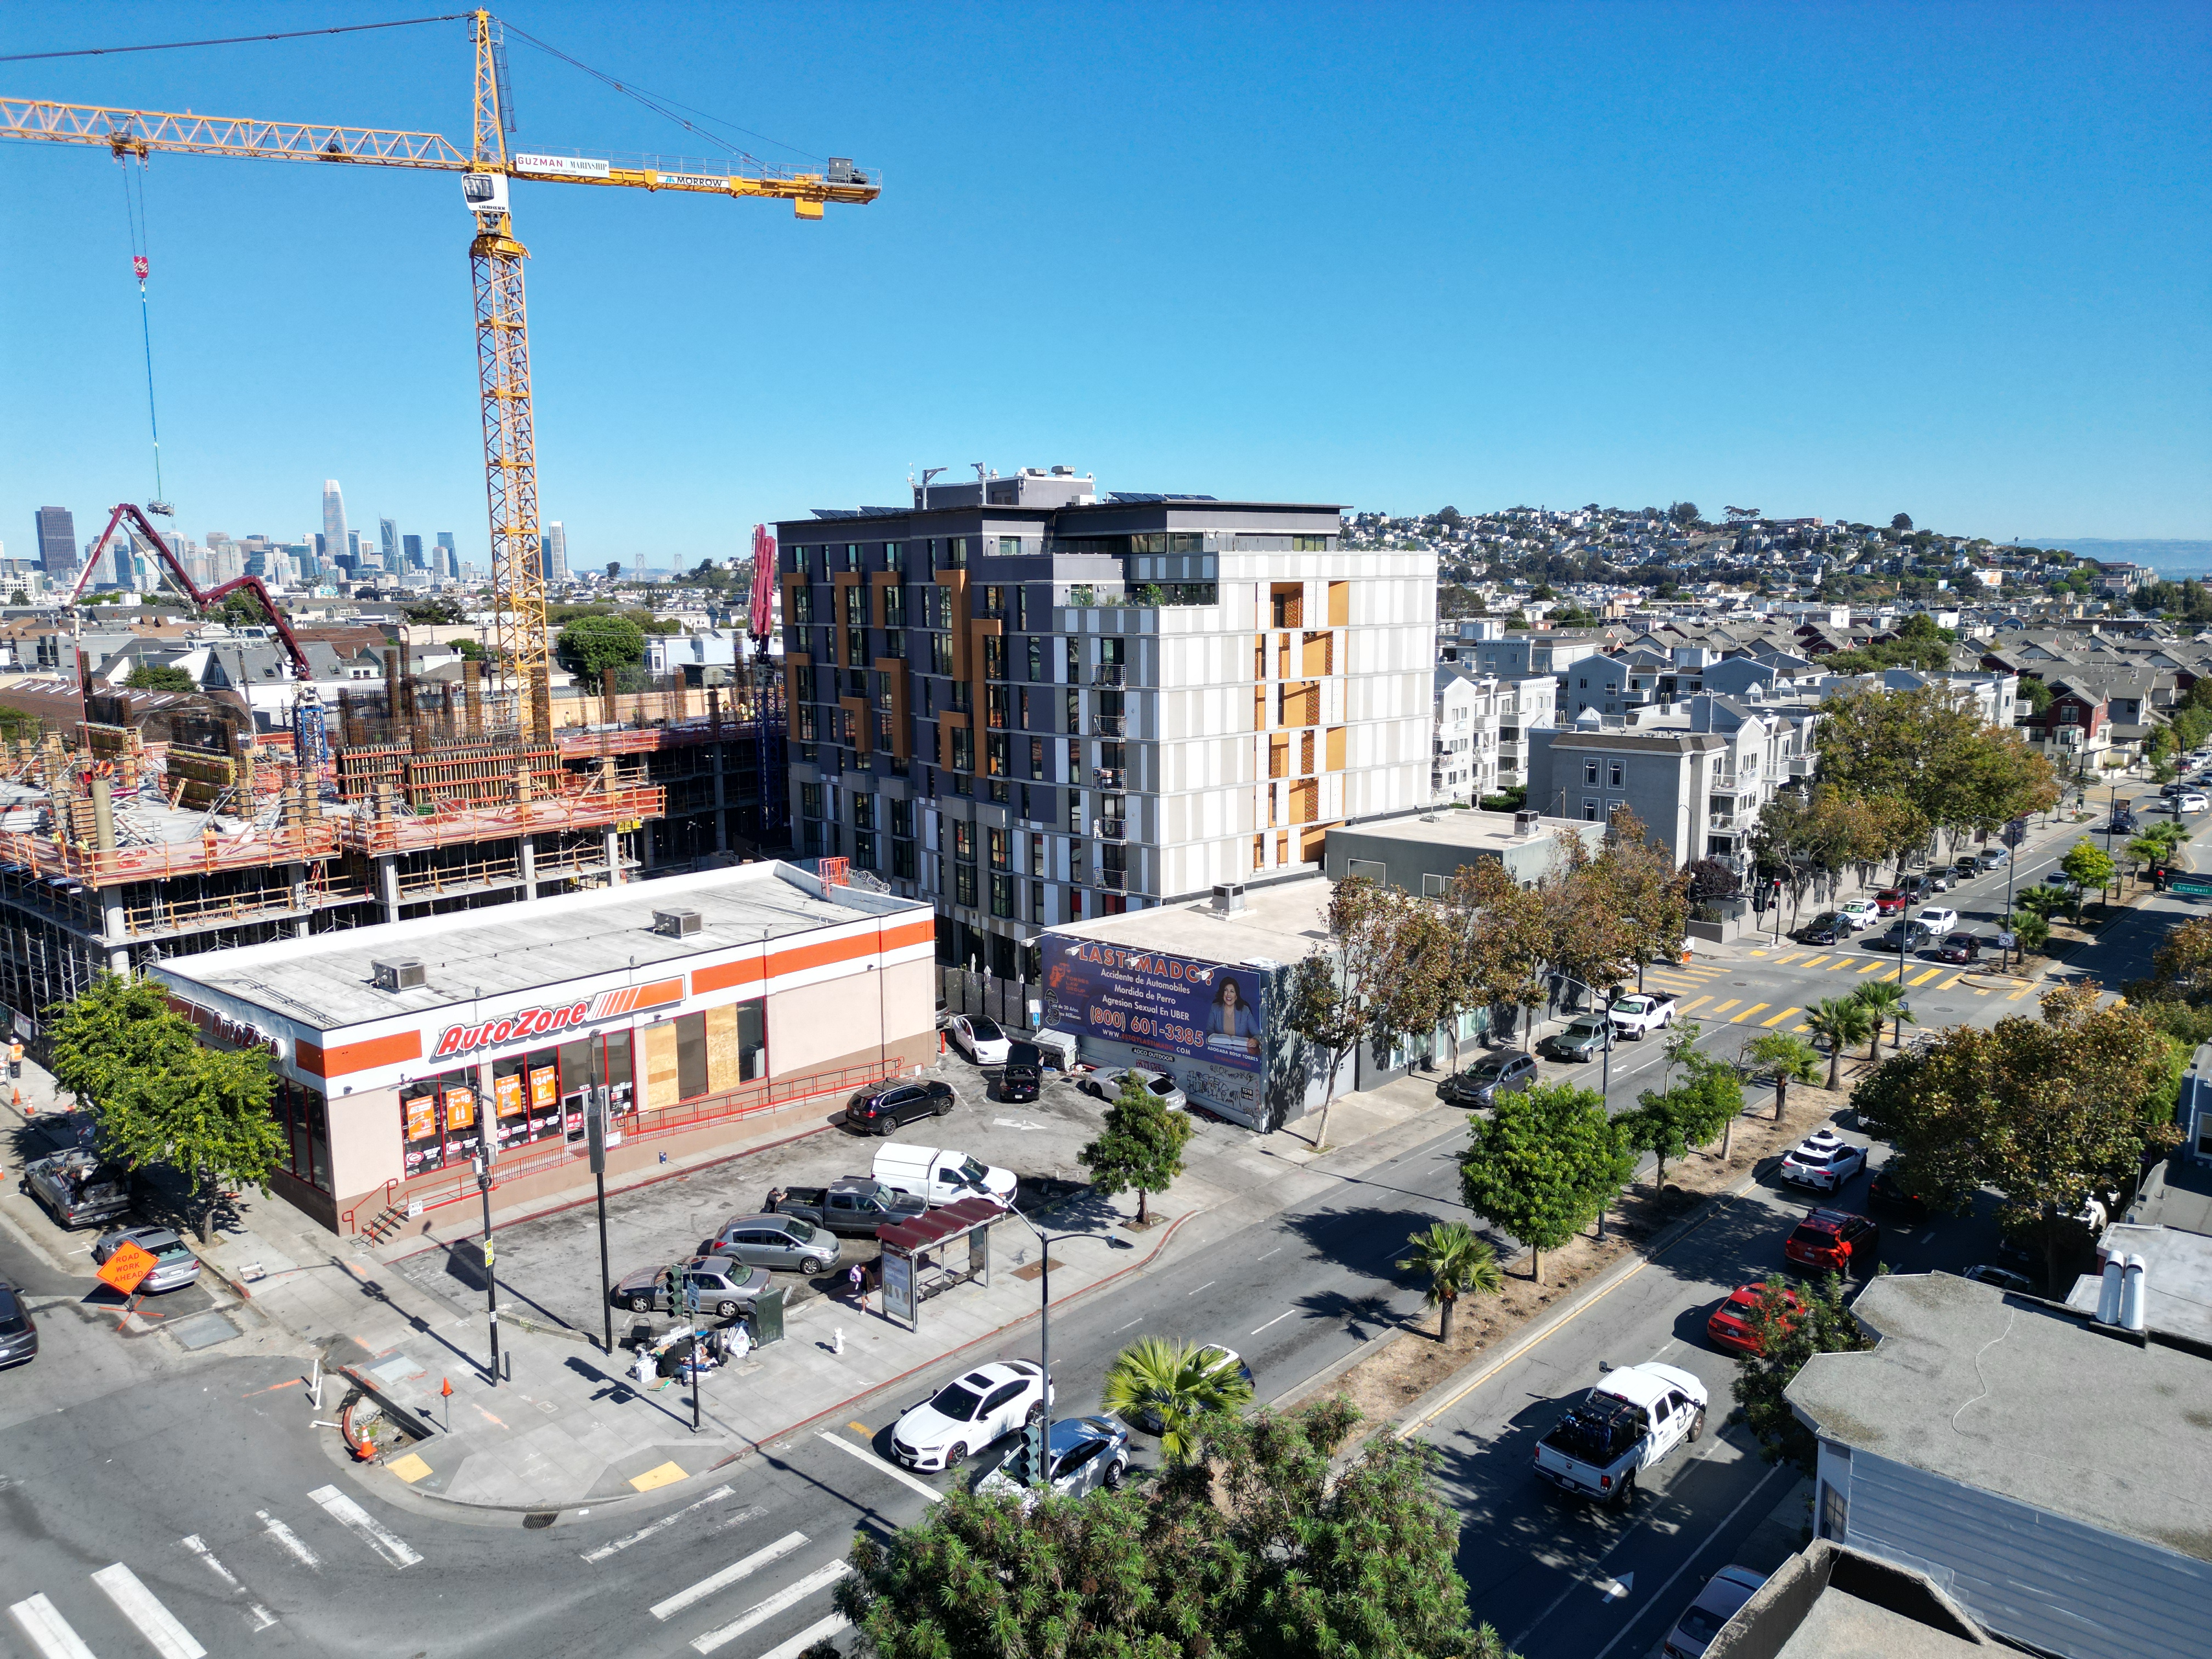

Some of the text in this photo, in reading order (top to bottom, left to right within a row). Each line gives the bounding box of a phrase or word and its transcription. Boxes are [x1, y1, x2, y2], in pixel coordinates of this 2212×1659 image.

[518, 157, 607, 171] GUZMAN MARINSHIP
[677, 177, 723, 187] MORROW
[1079, 945, 1214, 986] LASTIMADO?
[1066, 977, 1089, 985] TORRES
[1101, 968, 1190, 994] Accidente de Automobiles
[1115, 984, 1176, 1005] Mordida de Perro
[1102, 995, 1189, 1021] Agresion Sexual En UBER
[437, 1002, 587, 1055] AutoZone
[1090, 1005, 1204, 1047] (800) 601-3385
[1207, 1046, 1228, 1054] ABOGADA
[1148, 1052, 1173, 1062] OUTDOOR
[449, 1098, 455, 1107] 2
[461, 1094, 471, 1103] $8
[116, 1252, 139, 1263] ROAD
[116, 1262, 140, 1273] WORK
[114, 1271, 143, 1283] AHEAD
